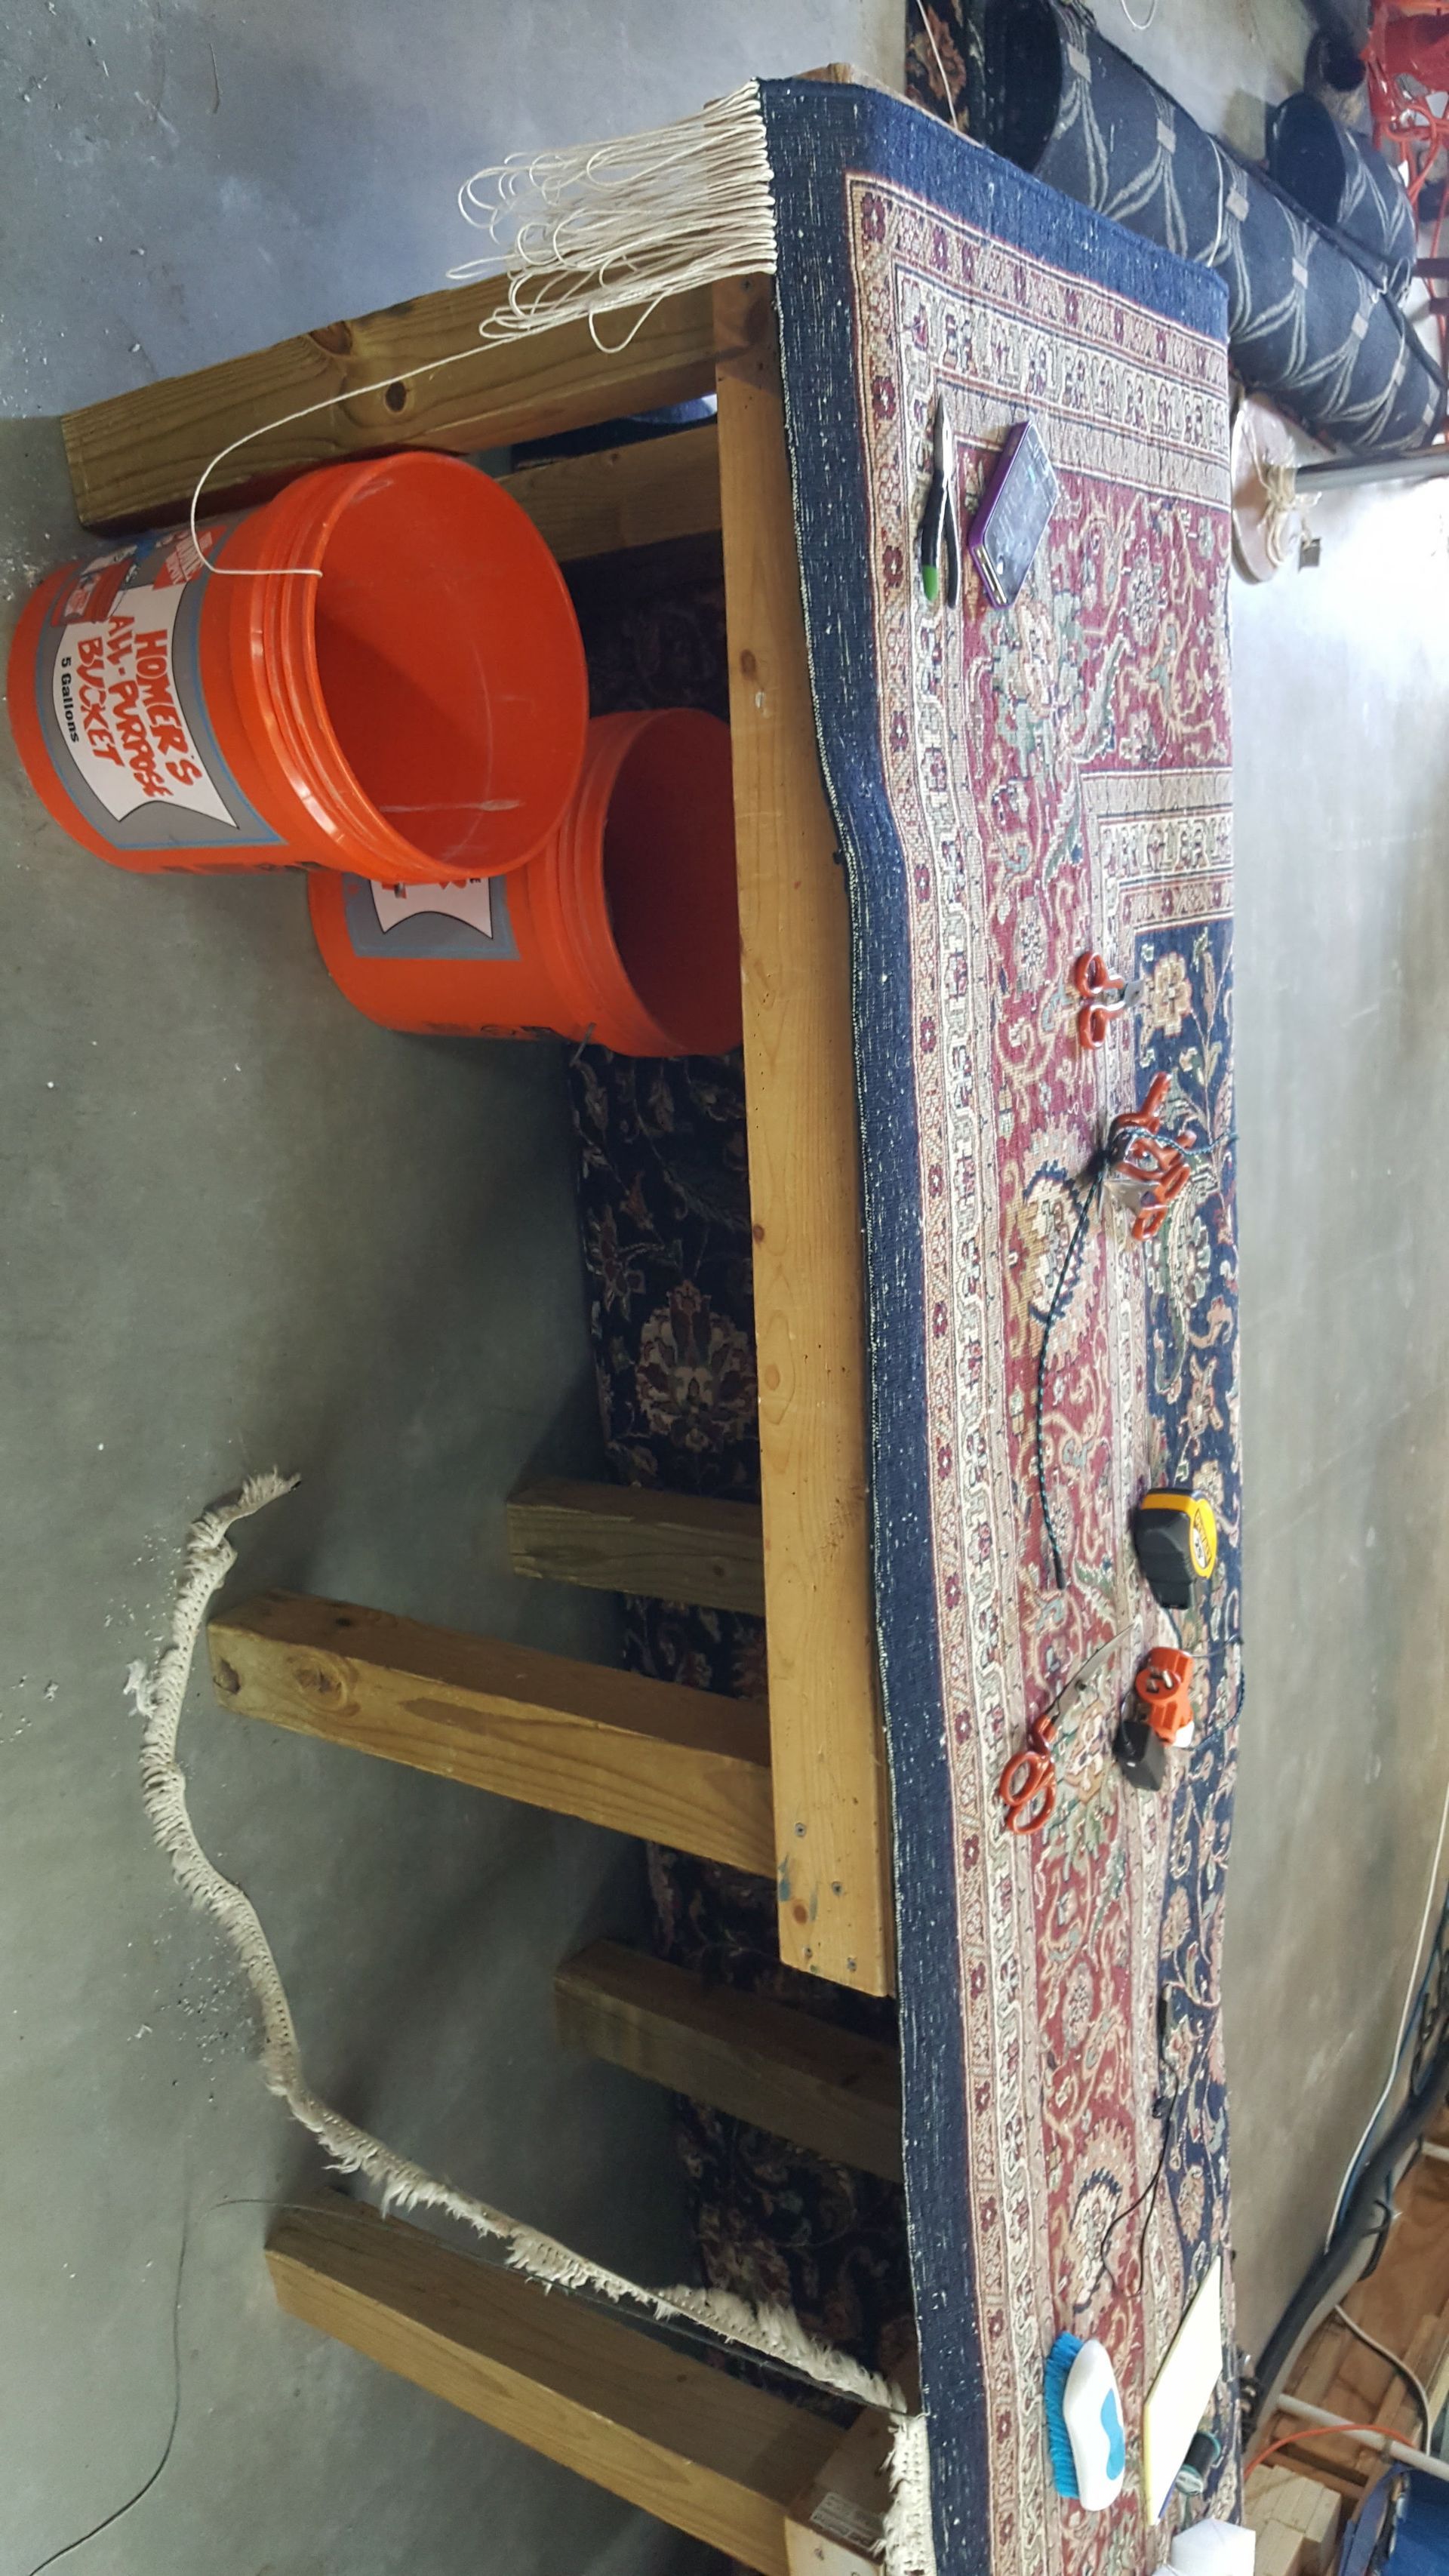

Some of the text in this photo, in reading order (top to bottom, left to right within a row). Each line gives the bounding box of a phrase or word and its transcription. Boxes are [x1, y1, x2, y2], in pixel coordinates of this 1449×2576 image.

[61, 656, 79, 743] 5 Gallons
[76, 636, 125, 768] BUCKET
[134, 629, 203, 786] HOMER'S
